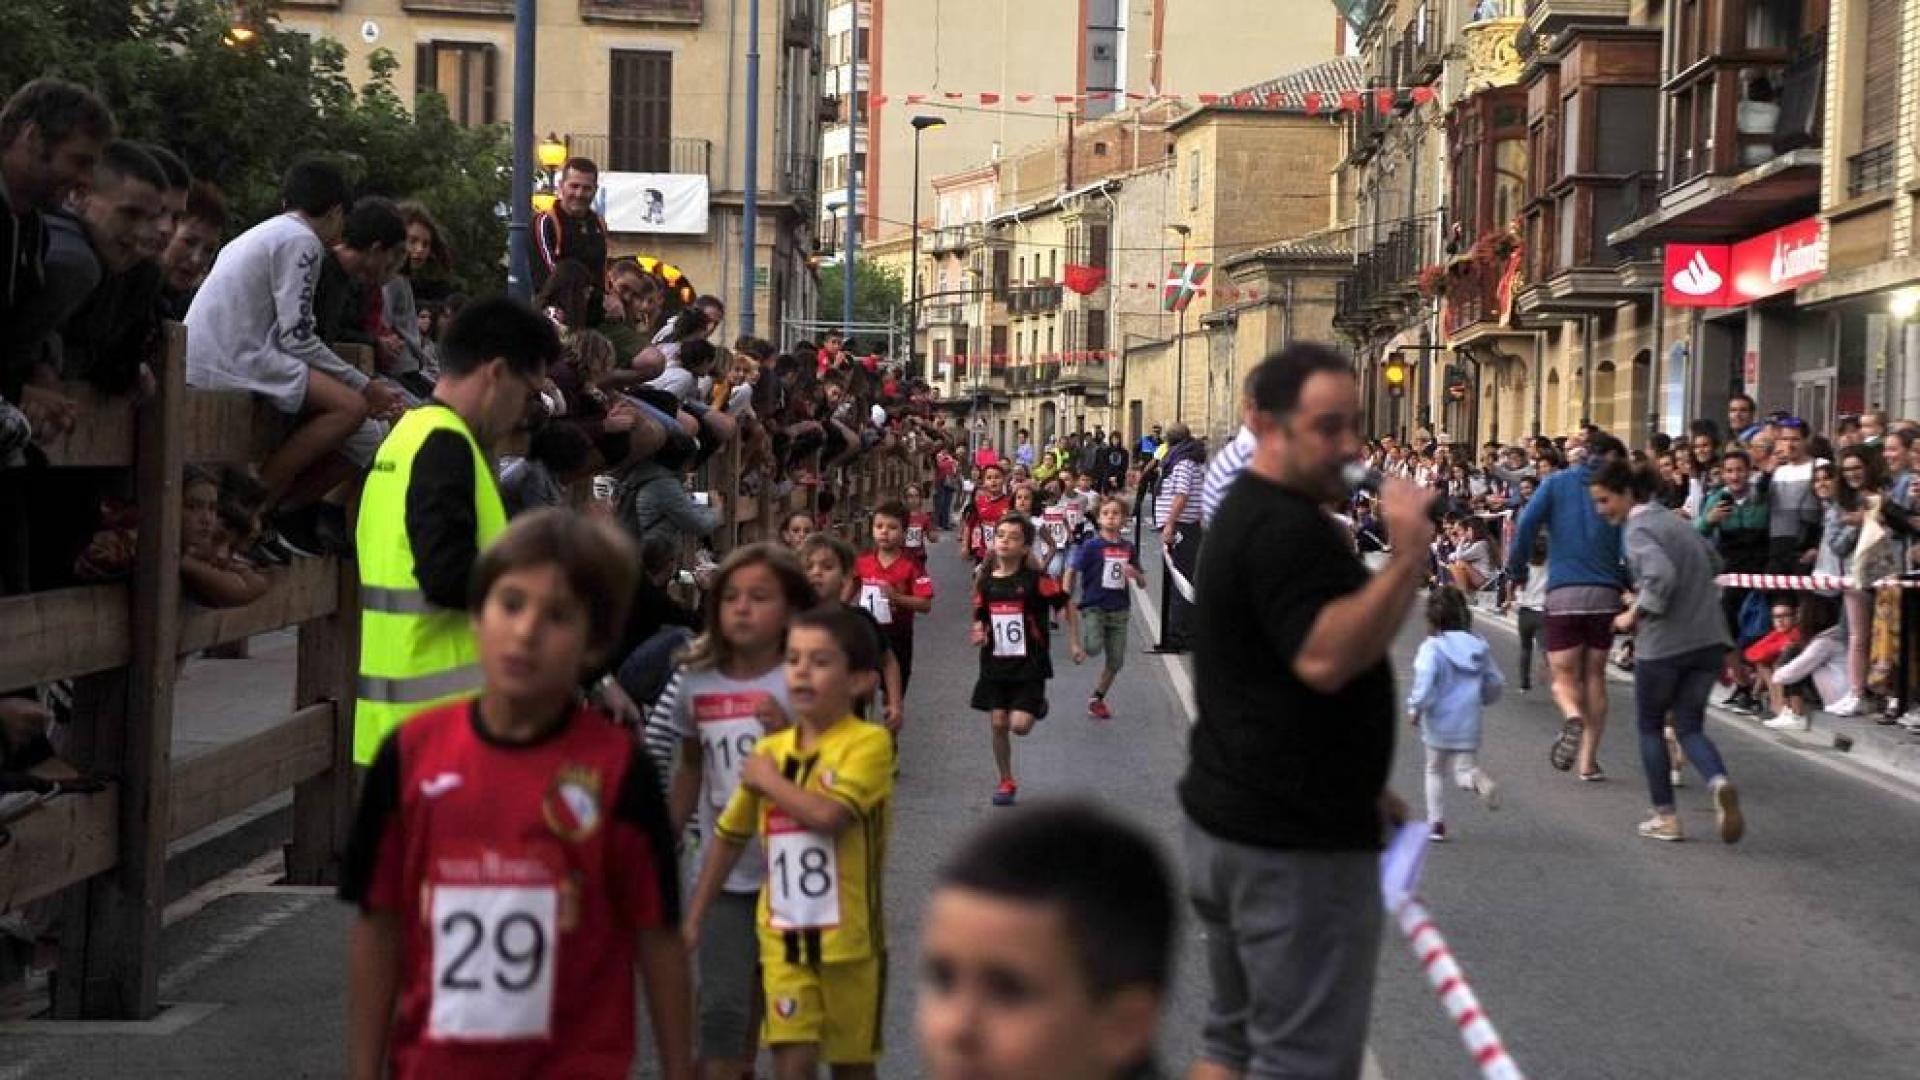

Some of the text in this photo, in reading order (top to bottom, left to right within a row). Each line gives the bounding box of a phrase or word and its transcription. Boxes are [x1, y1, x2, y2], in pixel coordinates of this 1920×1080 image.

[1111, 561, 1122, 581] 8
[996, 620, 1021, 644] 16
[774, 847, 831, 899] 18
[442, 911, 546, 992] 29
